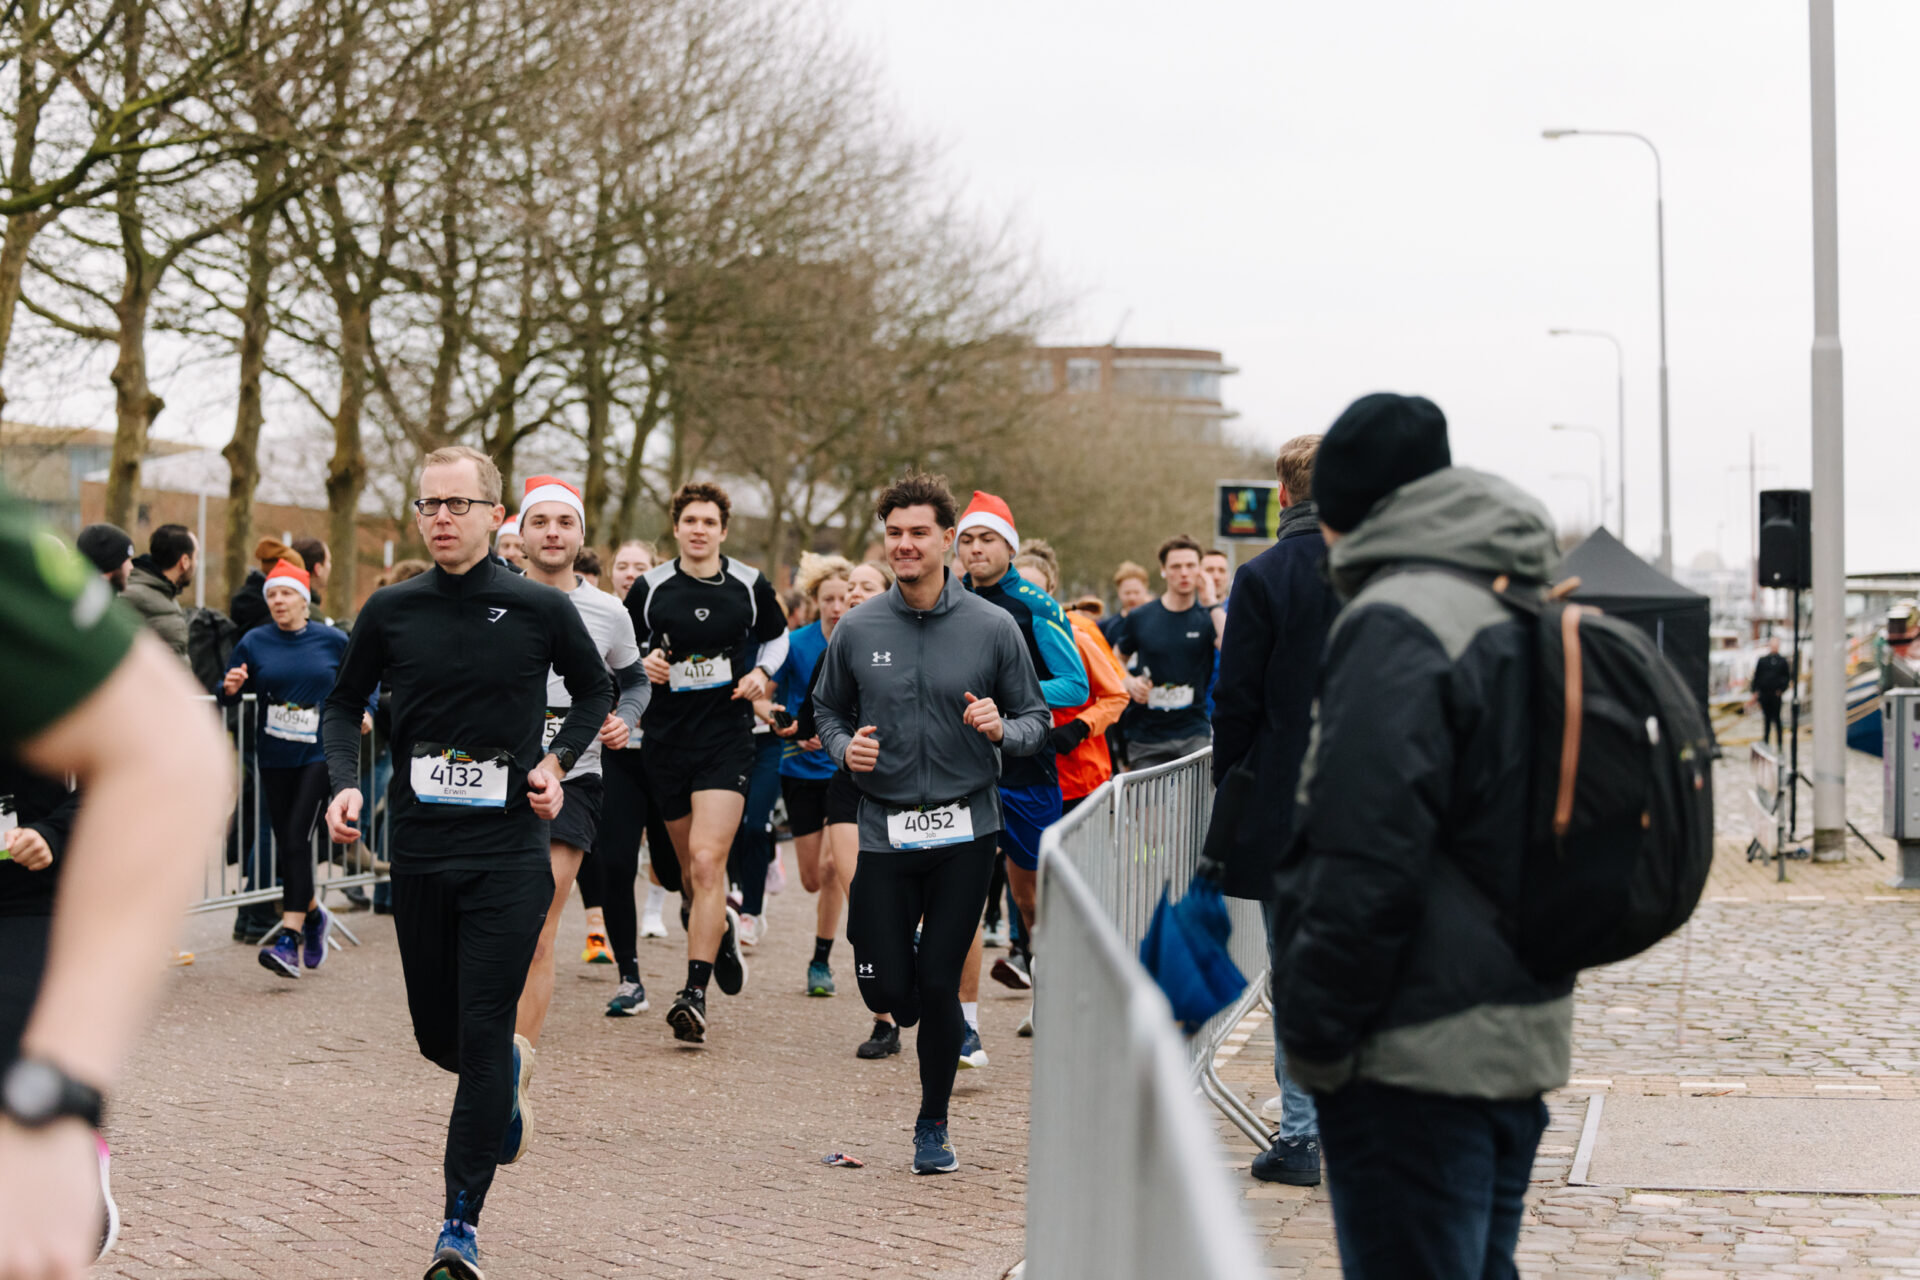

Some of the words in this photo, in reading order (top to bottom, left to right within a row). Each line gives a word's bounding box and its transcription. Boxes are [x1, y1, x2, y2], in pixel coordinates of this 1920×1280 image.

[684, 663, 715, 679] 4112
[275, 710, 309, 725] 4094
[430, 764, 483, 787] 4132
[443, 787, 467, 796] Erwin
[904, 811, 955, 832] 4052
[925, 831, 937, 839] Job
